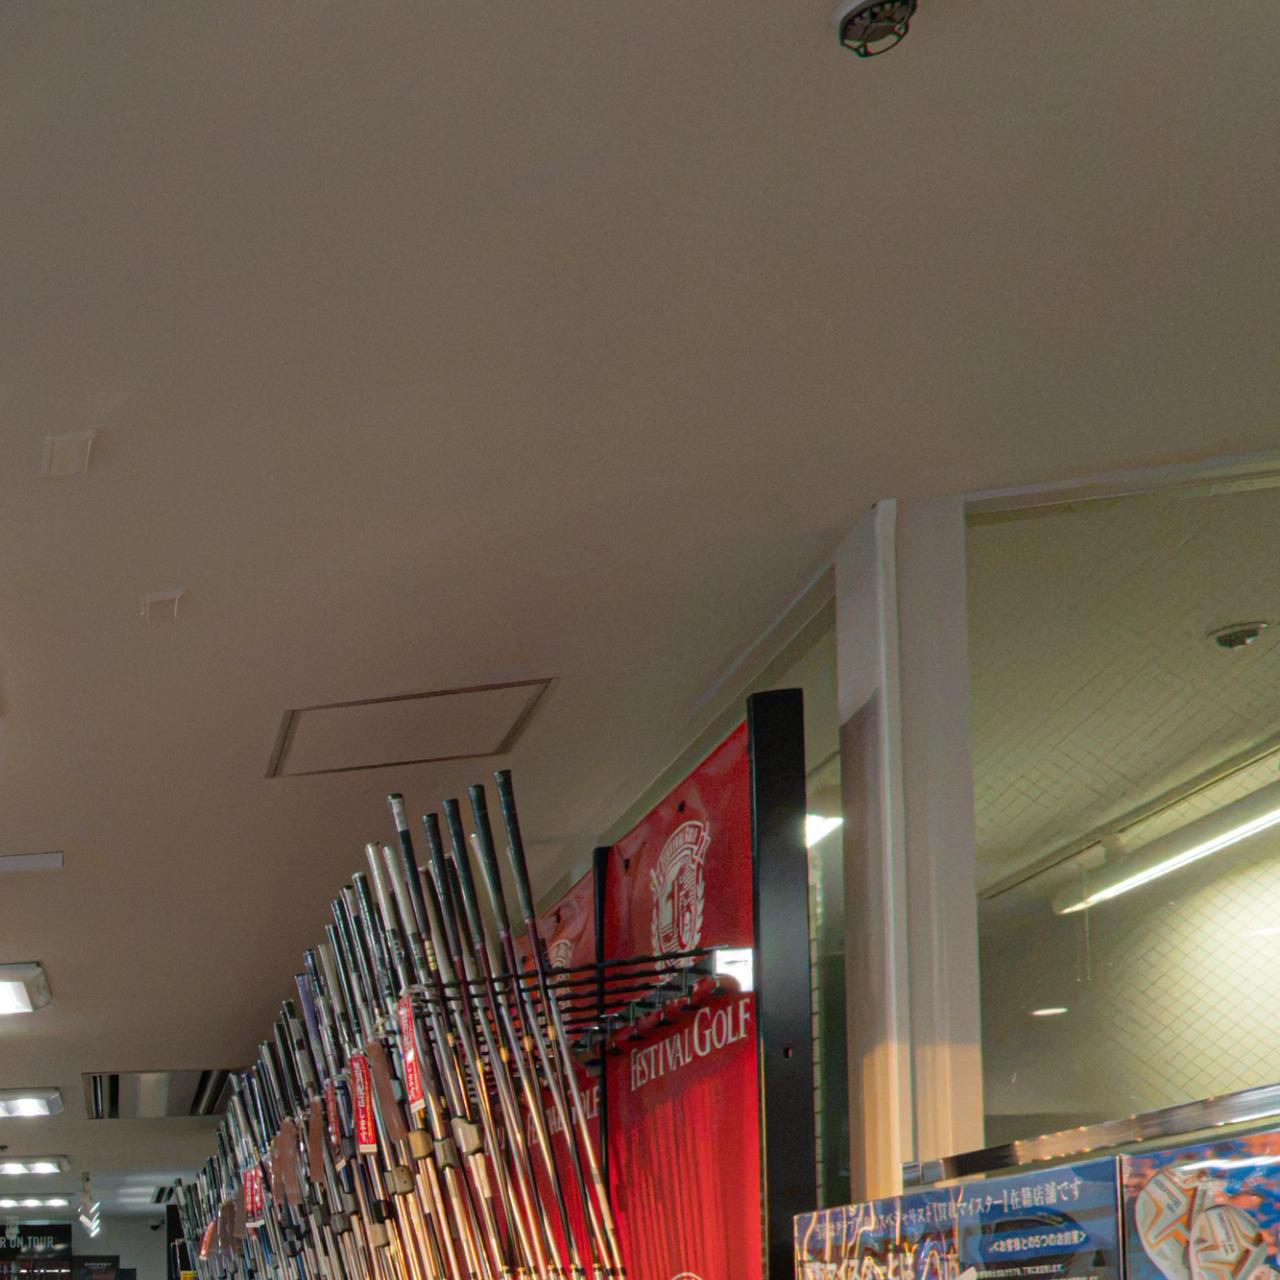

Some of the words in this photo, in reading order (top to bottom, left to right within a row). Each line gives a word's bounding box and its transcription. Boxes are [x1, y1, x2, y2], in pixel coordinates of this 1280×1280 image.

[630, 1036, 693, 1093] FESTIVAL
[692, 998, 751, 1058] GOLF
[10, 1237, 25, 1250] ON
